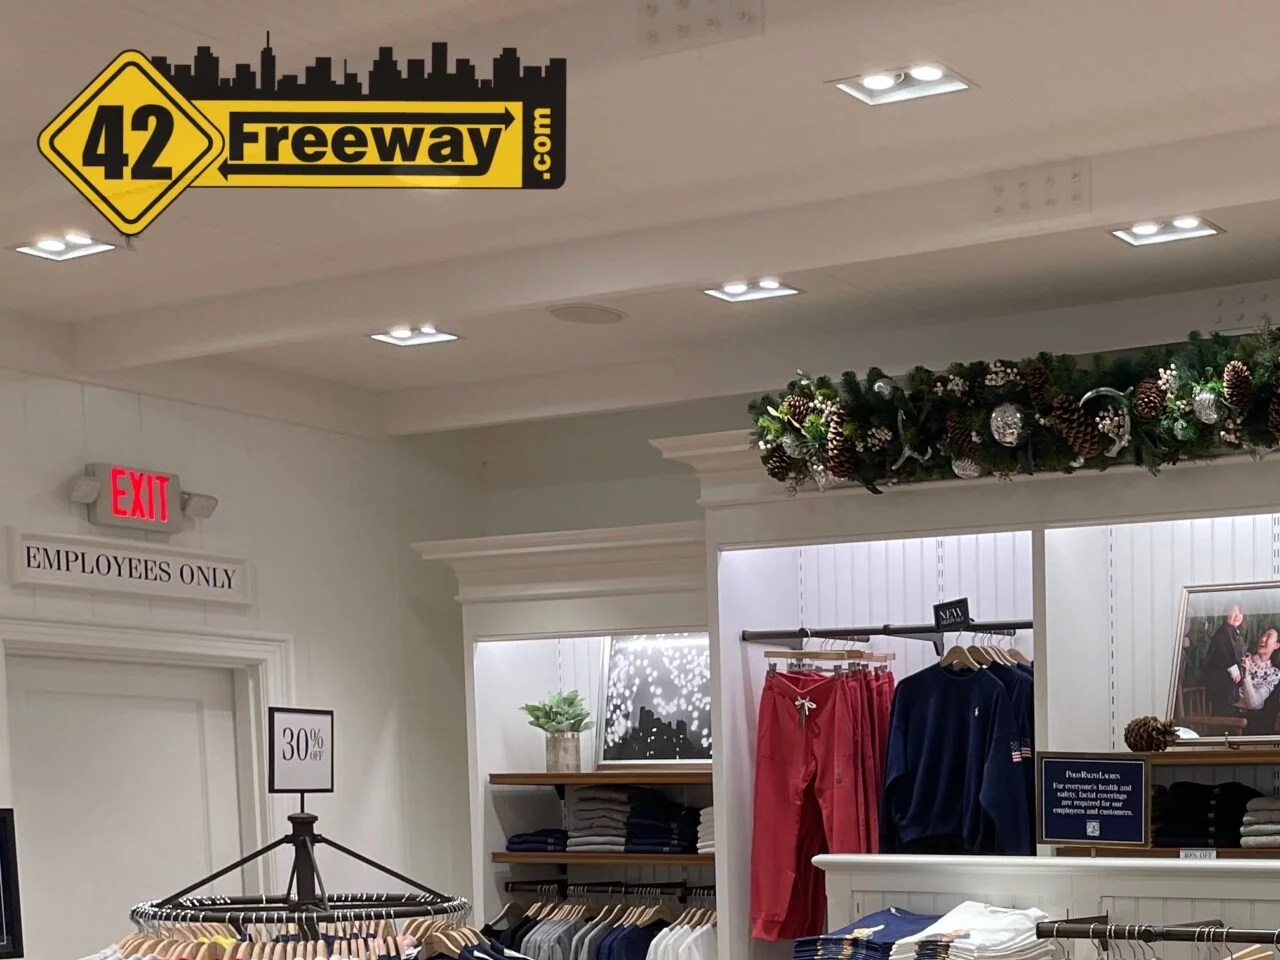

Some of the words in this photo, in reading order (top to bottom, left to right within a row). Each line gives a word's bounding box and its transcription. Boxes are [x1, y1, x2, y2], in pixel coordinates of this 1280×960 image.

[111, 467, 171, 523] EXIT
[25, 545, 172, 583] EMPLOYEES
[180, 563, 236, 589] ONLY
[282, 727, 324, 761] 30%
